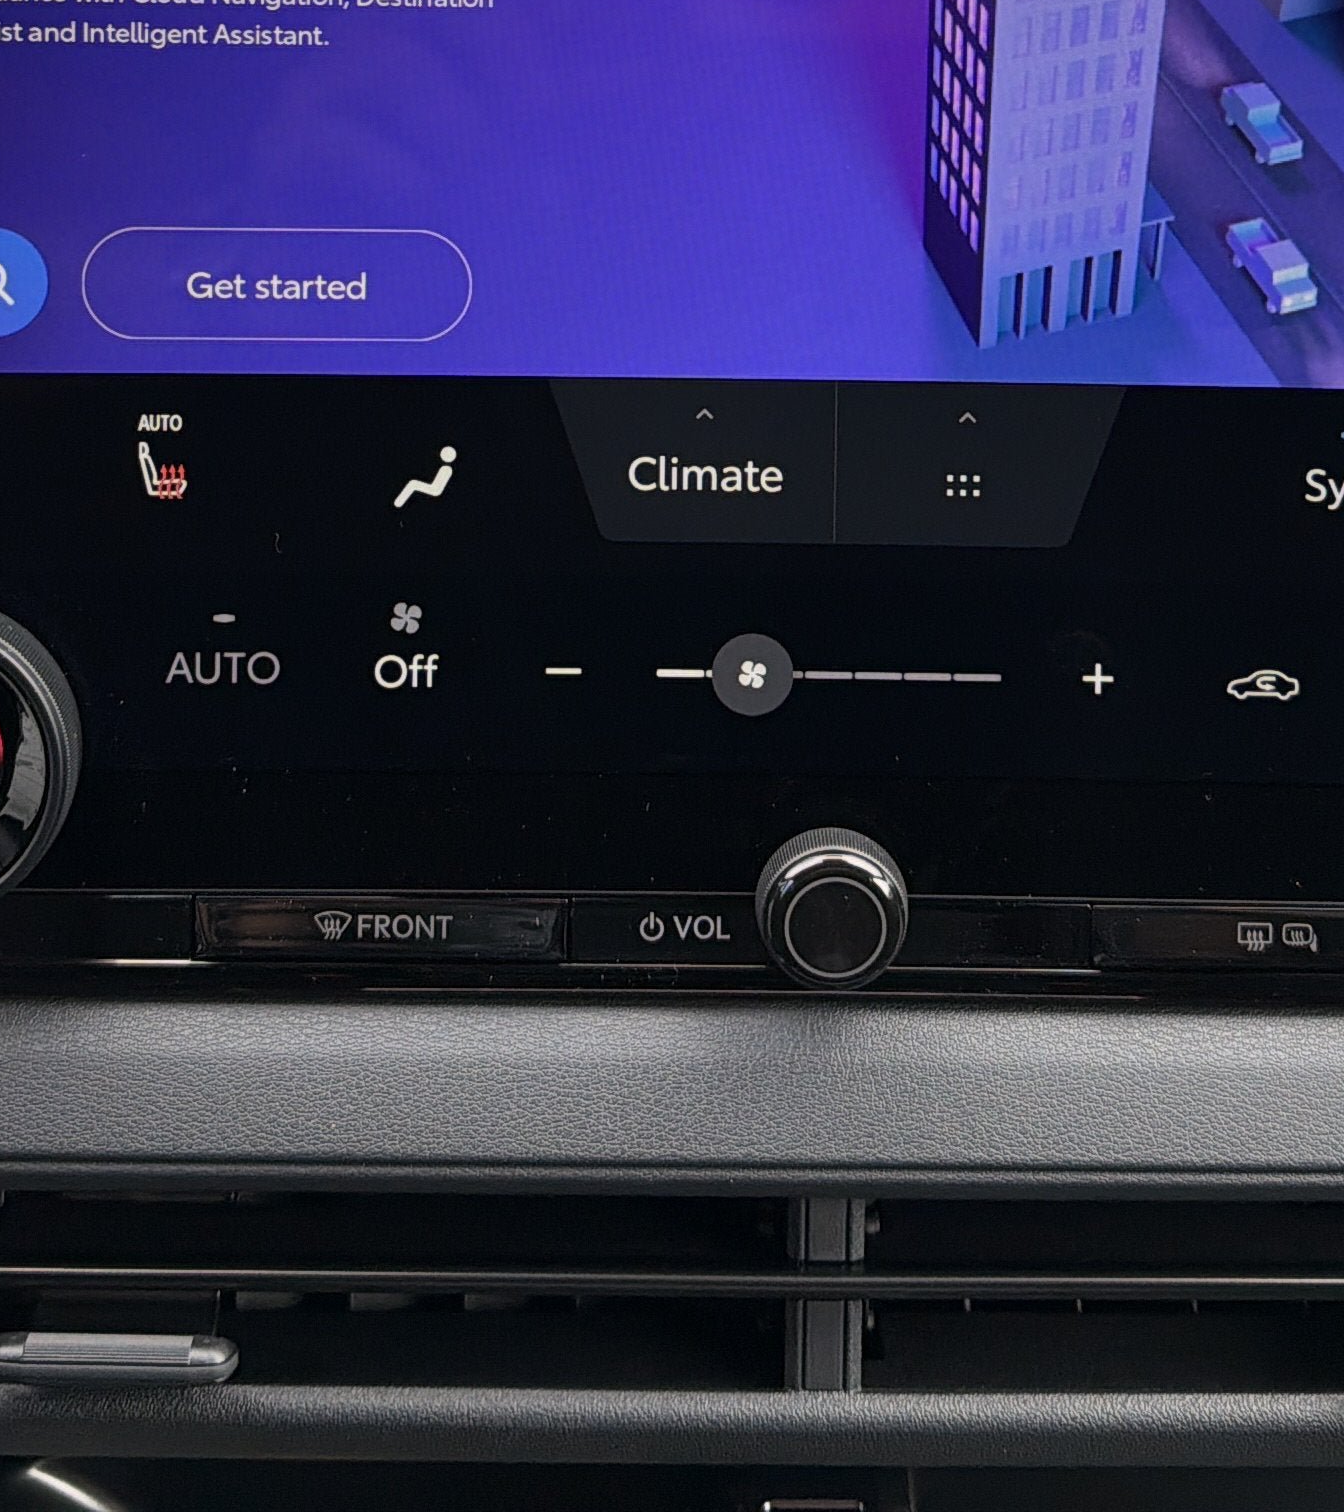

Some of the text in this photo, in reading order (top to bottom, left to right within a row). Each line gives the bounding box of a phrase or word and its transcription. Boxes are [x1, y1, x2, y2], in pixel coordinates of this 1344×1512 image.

[28, 20, 75, 44] and
[83, 21, 208, 49] Intelligent
[213, 23, 329, 48] Assistant.
[186, 272, 367, 303] Get started
[137, 412, 183, 433] AUTO
[628, 454, 784, 494] Climate
[165, 651, 281, 686] AUTO
[373, 652, 440, 691] Off
[358, 914, 453, 942] FRONT
[672, 914, 730, 942] VOL
